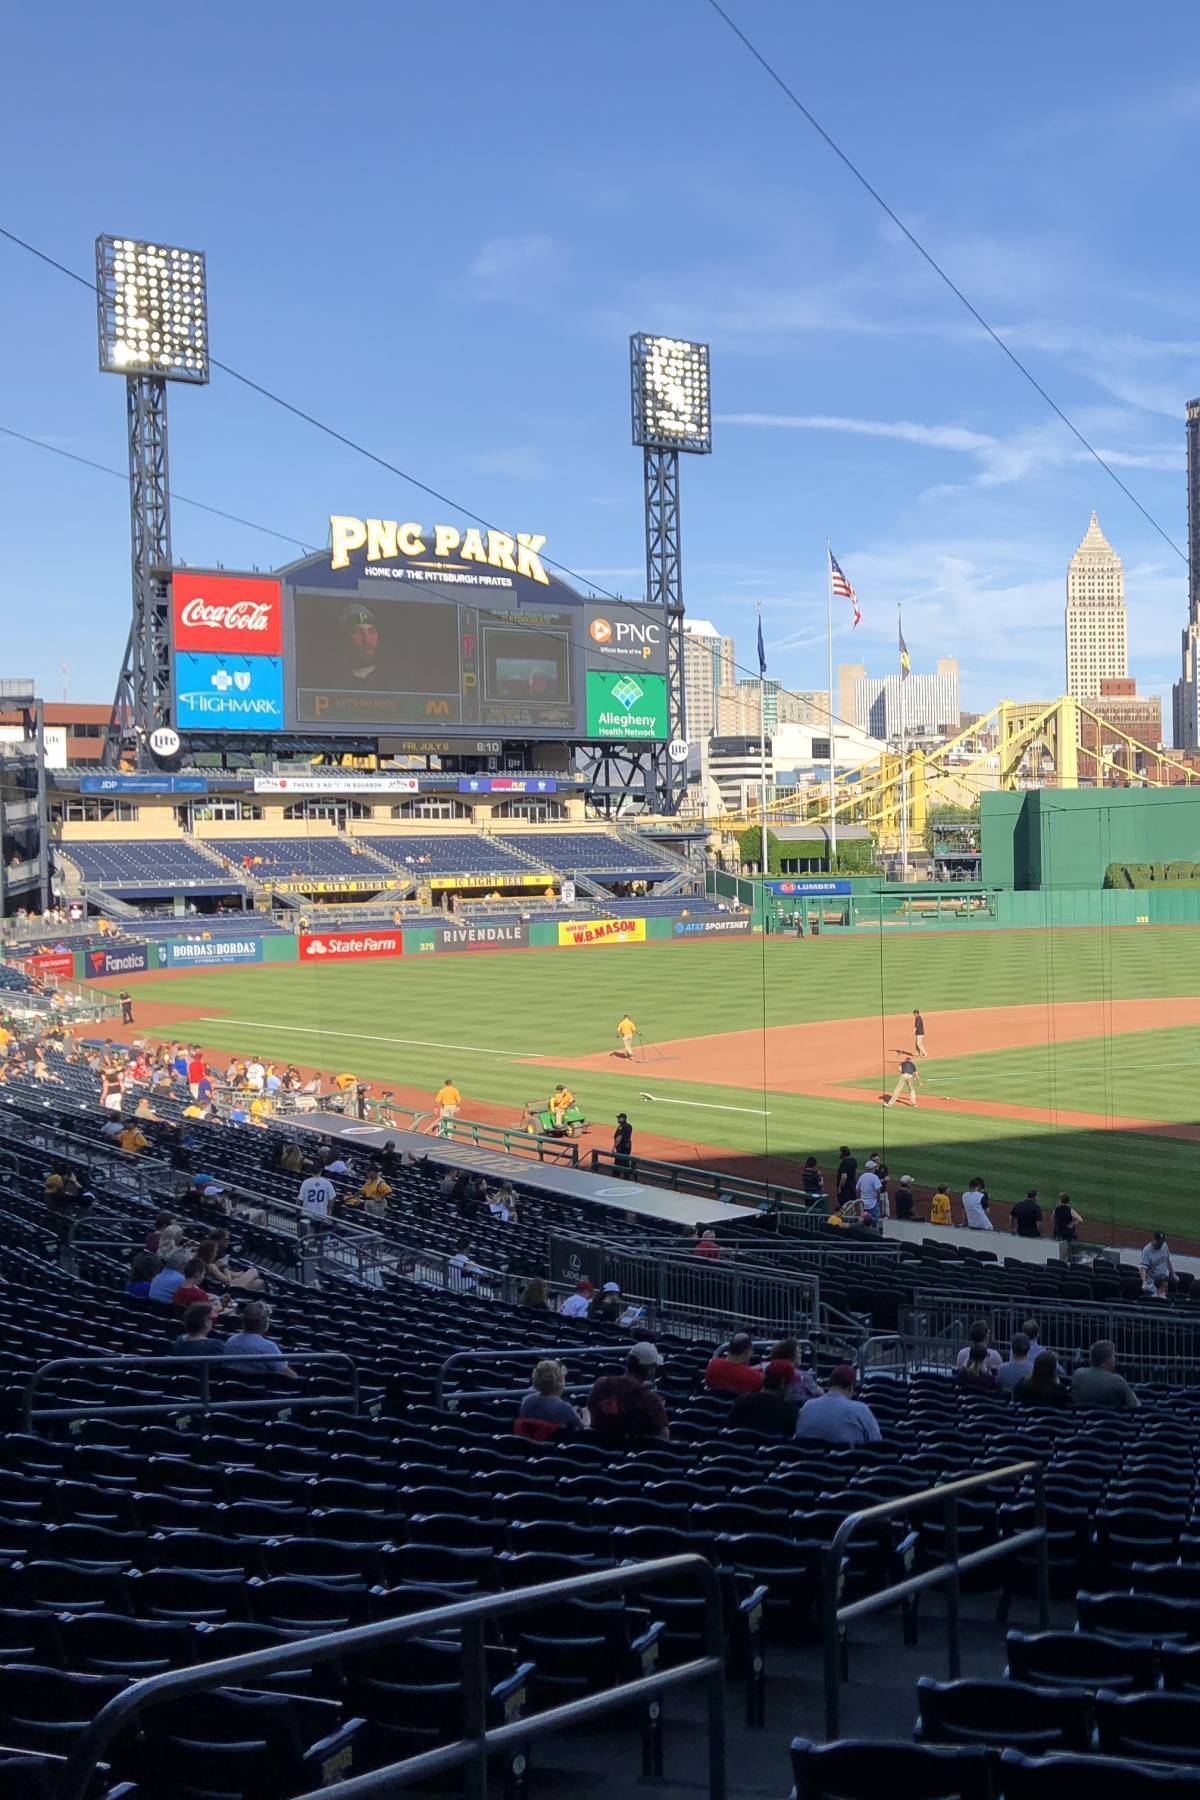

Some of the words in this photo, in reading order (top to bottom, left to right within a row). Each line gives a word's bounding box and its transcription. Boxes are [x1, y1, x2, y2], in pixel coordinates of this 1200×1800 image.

[330, 515, 427, 571] PNC
[434, 524, 550, 586] PARK
[364, 566, 390, 578] HOME
[391, 568, 404, 578] OF
[405, 569, 424, 580] THE
[424, 570, 478, 585] PITTSBURGH
[478, 575, 513, 588] PIRATES
[181, 597, 273, 631] Coca-Cola
[614, 622, 660, 644] PNC
[182, 694, 280, 715] HIGHMARK
[598, 712, 656, 727] Allegheny
[598, 728, 624, 736] Health
[624, 728, 655, 737] Network
[154, 734, 177, 749] Lite
[419, 742, 441, 751] JULY
[671, 744, 688, 756] Lite
[100, 780, 118, 789] JDP
[288, 882, 319, 892] IRON
[323, 882, 351, 892] CITY
[356, 881, 389, 891] BEER
[466, 877, 499, 887] LIGHT
[502, 877, 525, 886] BEER
[797, 882, 836, 892] LUMBER
[685, 922, 704, 932] AT&T
[704, 920, 749, 931] SPORTSNET
[443, 927, 522, 943] RIVENDALE
[173, 944, 214, 958] BORDAS
[216, 942, 256, 956] BORDAS
[105, 953, 145, 972] Fanatics
[307, 1188, 326, 1203] 20
[561, 1268, 590, 1281] LEXUS
